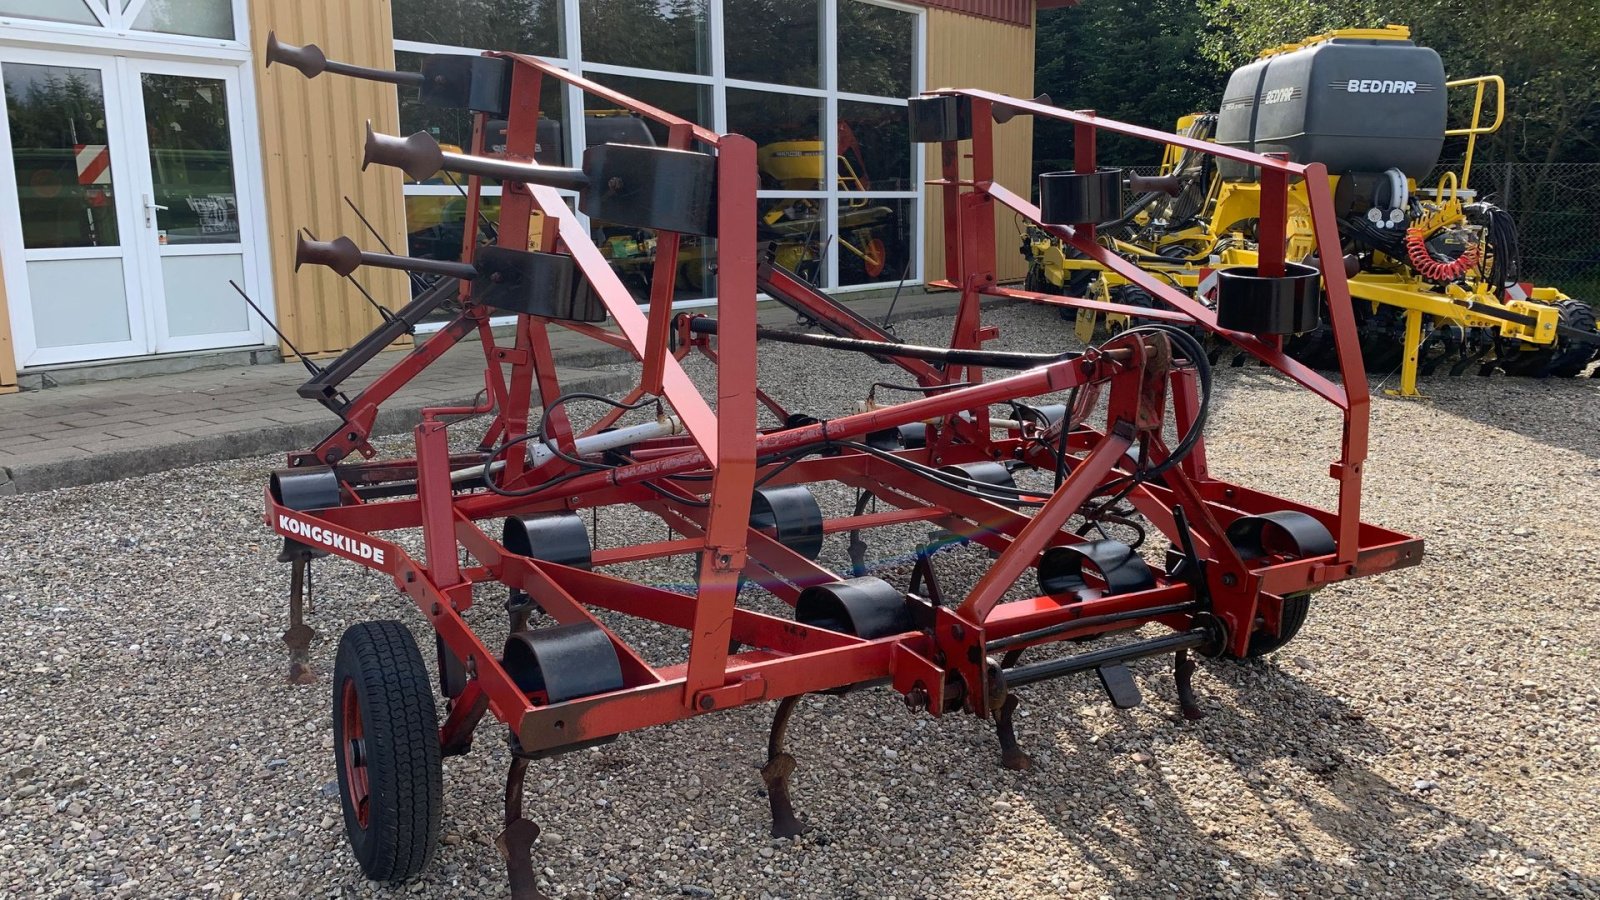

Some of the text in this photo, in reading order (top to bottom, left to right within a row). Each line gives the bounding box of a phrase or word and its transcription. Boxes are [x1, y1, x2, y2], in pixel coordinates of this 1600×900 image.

[1265, 86, 1294, 105] BEDNAR
[1347, 79, 1417, 94] BEDNAR
[279, 514, 384, 565] KONGSKILDE
